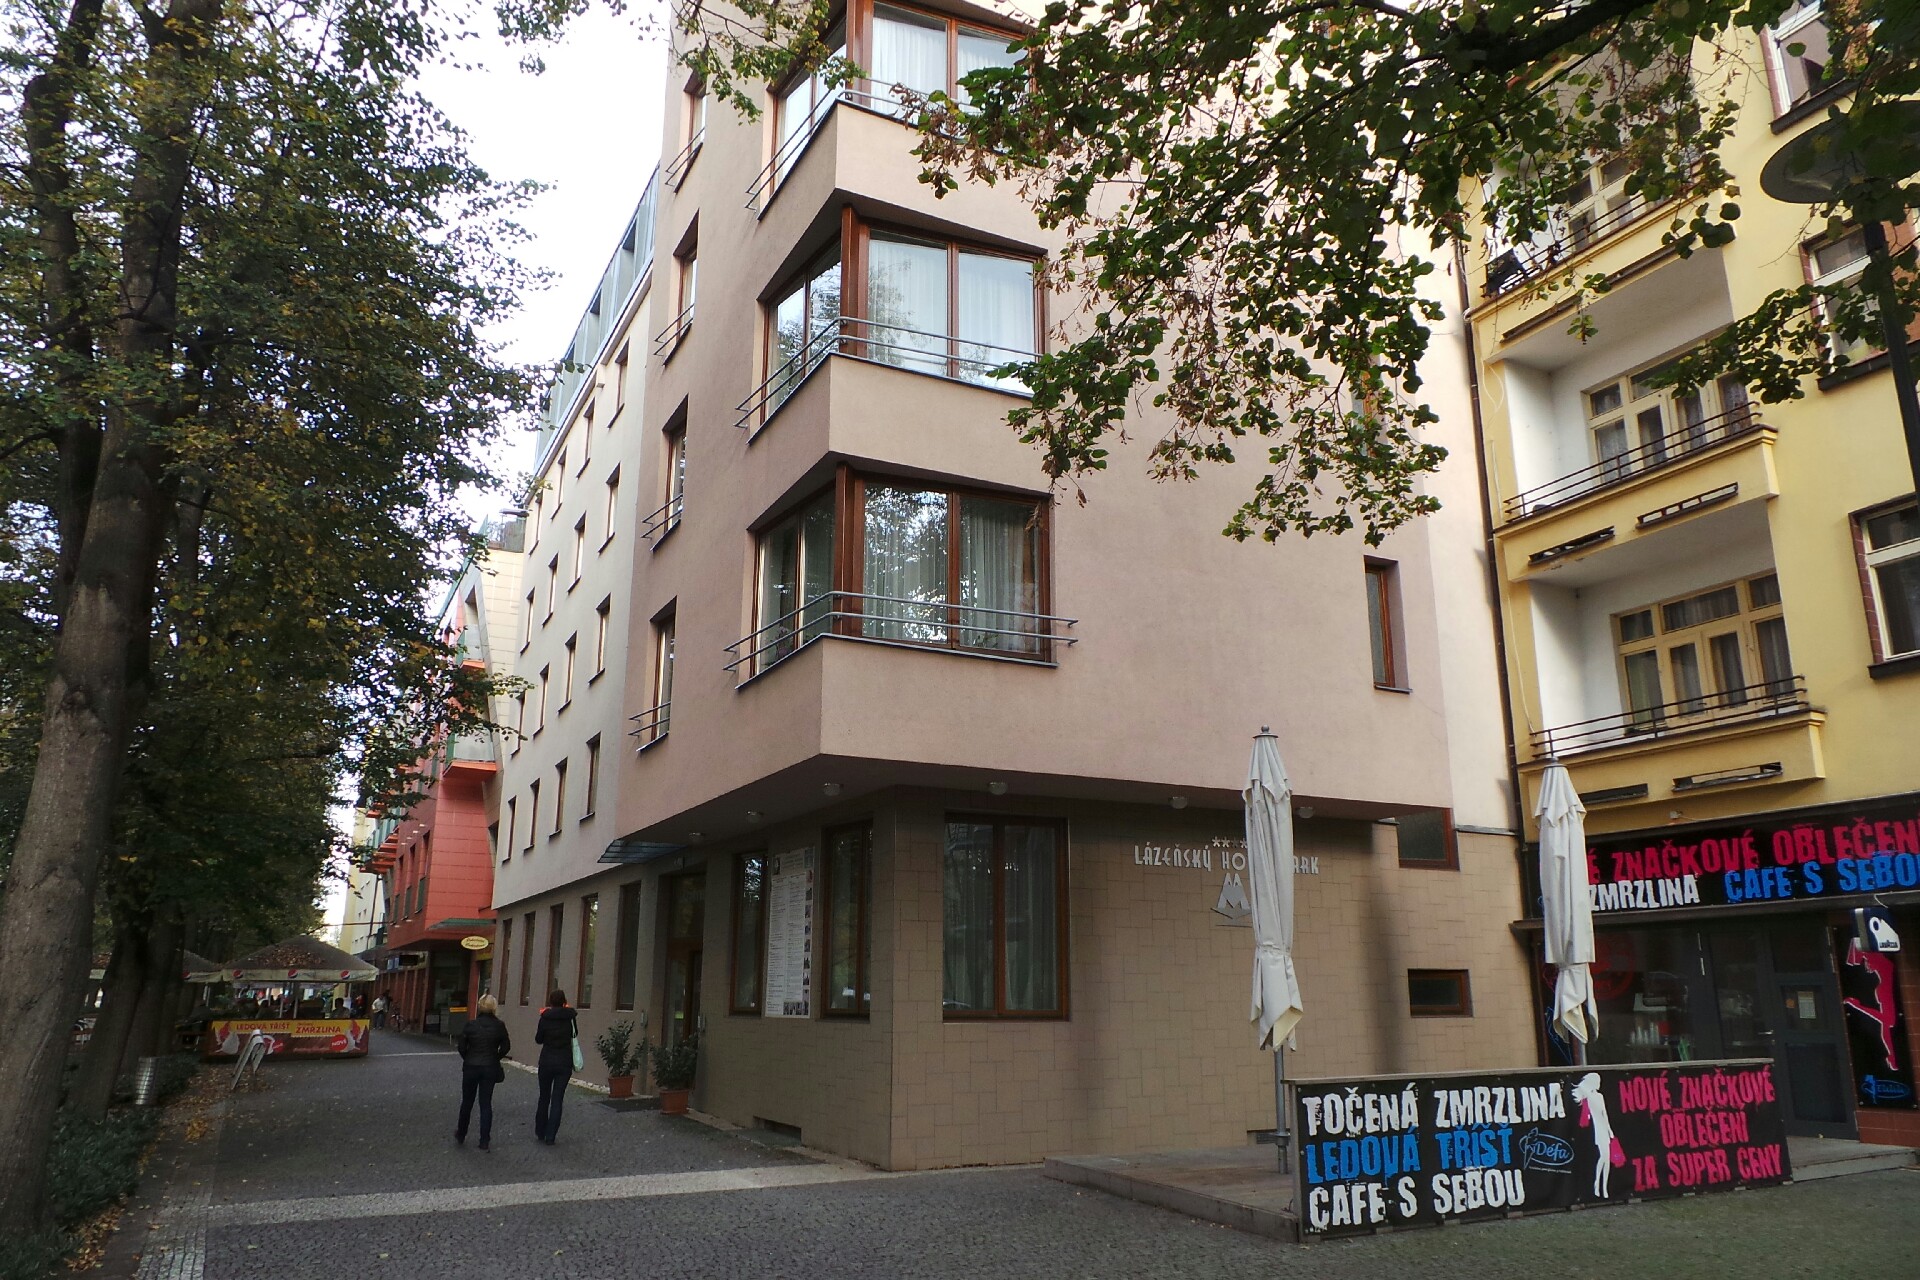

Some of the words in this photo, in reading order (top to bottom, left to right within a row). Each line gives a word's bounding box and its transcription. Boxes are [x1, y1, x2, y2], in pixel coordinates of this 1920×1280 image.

[1134, 841, 1212, 872] LÁZEŇSKÝ
[1612, 828, 1760, 882] ZNAČKOVÉ
[1589, 874, 1700, 912] ZMRZLINA
[1724, 866, 1791, 902] CAFE
[1804, 861, 1823, 894] S
[296, 1026, 341, 1034] ZMRZLINA
[1302, 1083, 1420, 1136] TOČENÁ
[1434, 1082, 1566, 1128] ZMRZLINA
[1618, 1070, 1673, 1114] NOVÉ
[1679, 1064, 1776, 1110] ZNAČKOVÉ
[1306, 1127, 1421, 1185] LEDOVÁ
[1632, 1155, 1660, 1192] ZA
[1667, 1149, 1731, 1187] SUPER
[1736, 1144, 1783, 1181] CENY
[1309, 1182, 1386, 1233] CAFE
[1397, 1175, 1418, 1218] S
[1432, 1167, 1526, 1214] SEBOU
